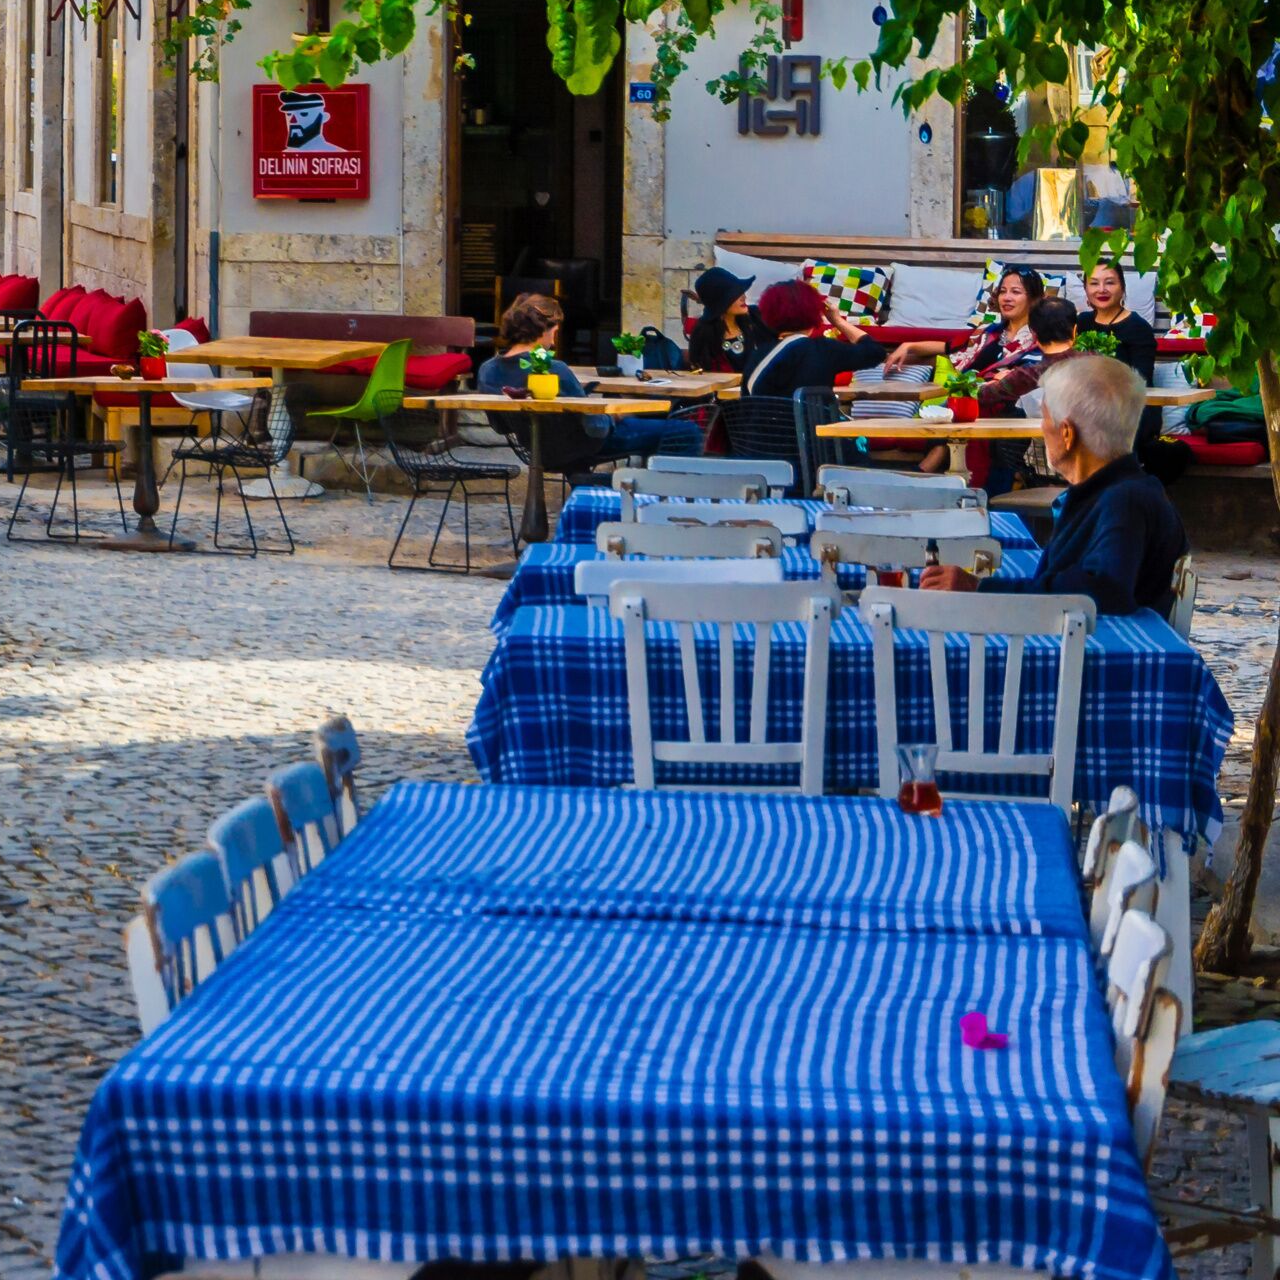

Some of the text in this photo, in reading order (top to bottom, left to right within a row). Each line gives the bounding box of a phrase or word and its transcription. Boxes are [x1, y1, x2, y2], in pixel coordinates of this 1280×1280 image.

[637, 89, 652, 99] 60
[259, 153, 361, 175] DELİNİN SOFRASI
